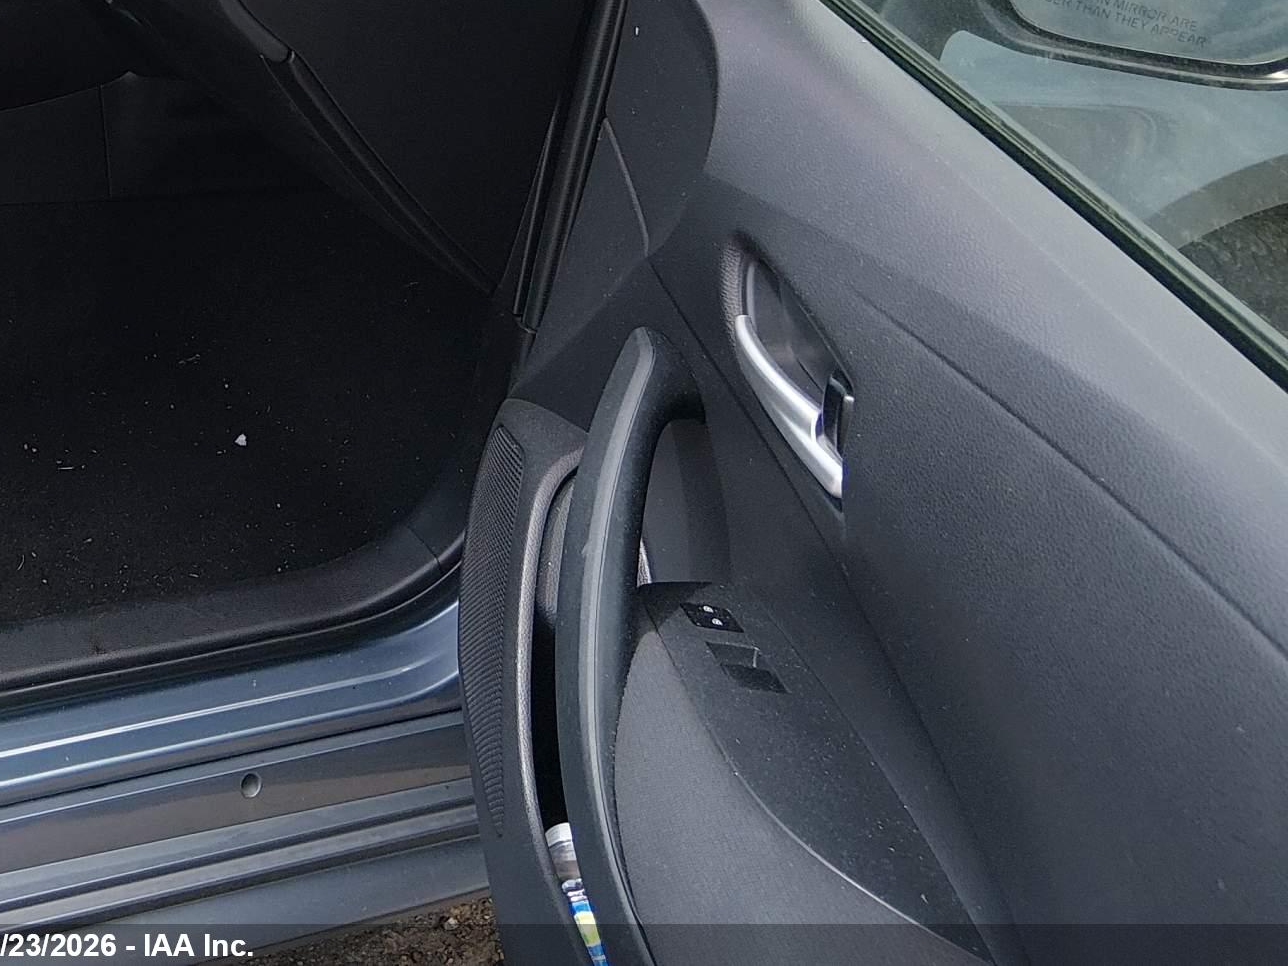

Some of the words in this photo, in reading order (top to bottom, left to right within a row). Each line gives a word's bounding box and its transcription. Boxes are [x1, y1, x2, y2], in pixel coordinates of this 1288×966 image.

[1076, 0, 1111, 19] THAN
[1116, 11, 1150, 30] THEY
[1151, 23, 1208, 48] APPEAR
[1169, 15, 1198, 32] ARE
